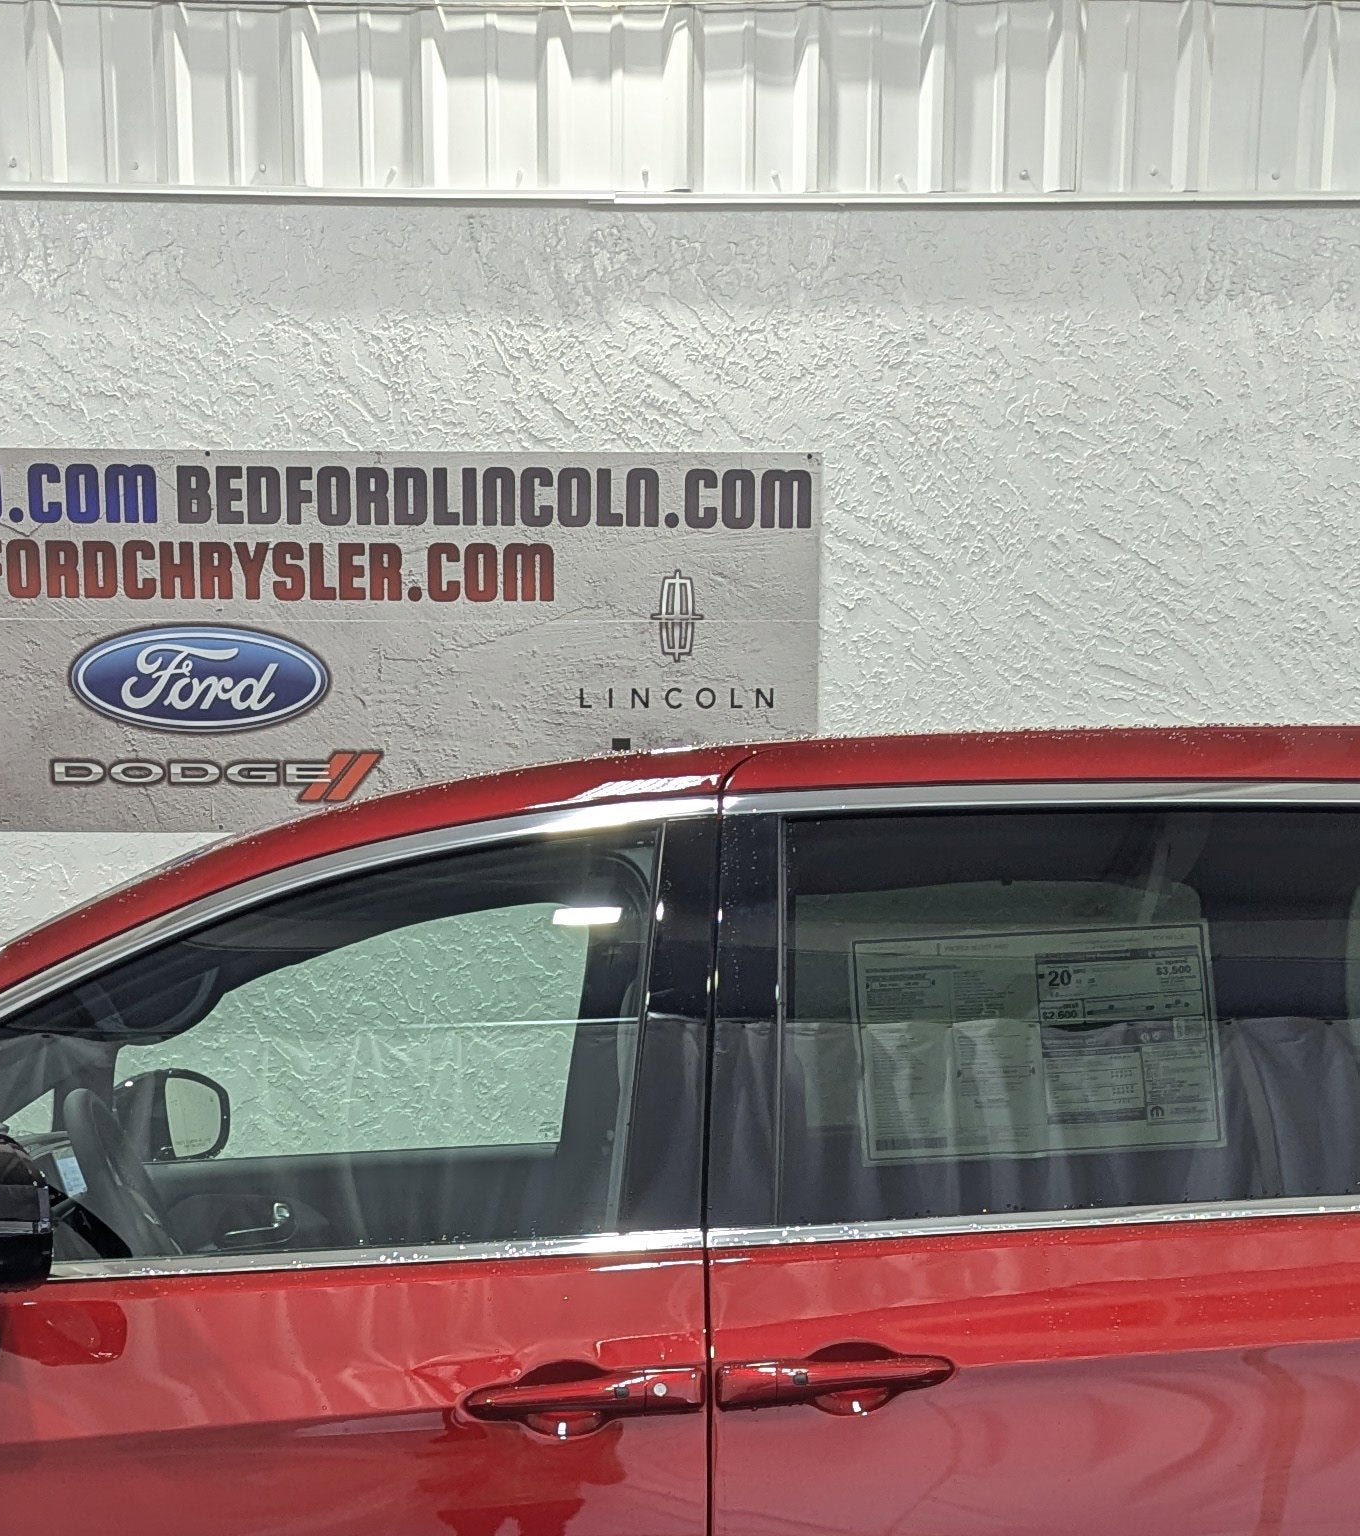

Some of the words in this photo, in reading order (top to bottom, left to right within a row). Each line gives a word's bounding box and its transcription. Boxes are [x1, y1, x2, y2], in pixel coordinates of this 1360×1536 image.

[176, 465, 813, 529] BEDFORDLINCOLN.COM
[121, 646, 278, 711] Ford
[579, 687, 776, 710] LINCOLN
[52, 758, 332, 786] DODGE
[1048, 969, 1072, 987] 20
